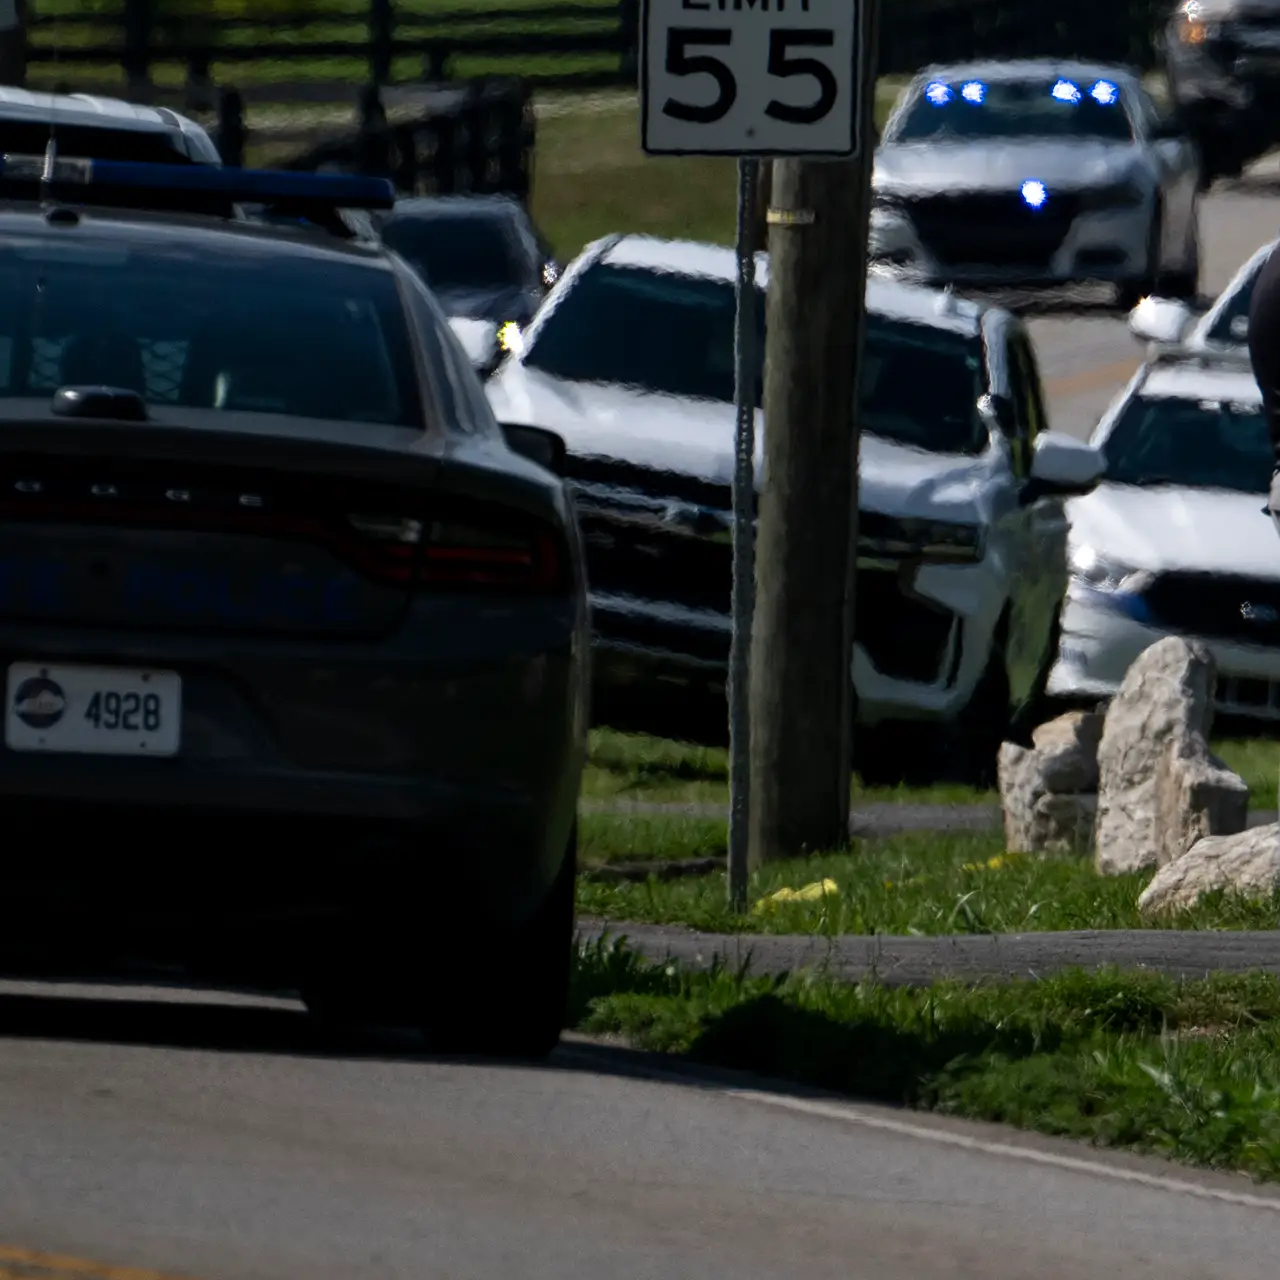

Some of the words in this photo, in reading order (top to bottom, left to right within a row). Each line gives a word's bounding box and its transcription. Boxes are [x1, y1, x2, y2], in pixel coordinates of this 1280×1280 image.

[662, 27, 837, 124] 55
[14, 478, 264, 507] ODGE
[84, 691, 161, 731] 4928
